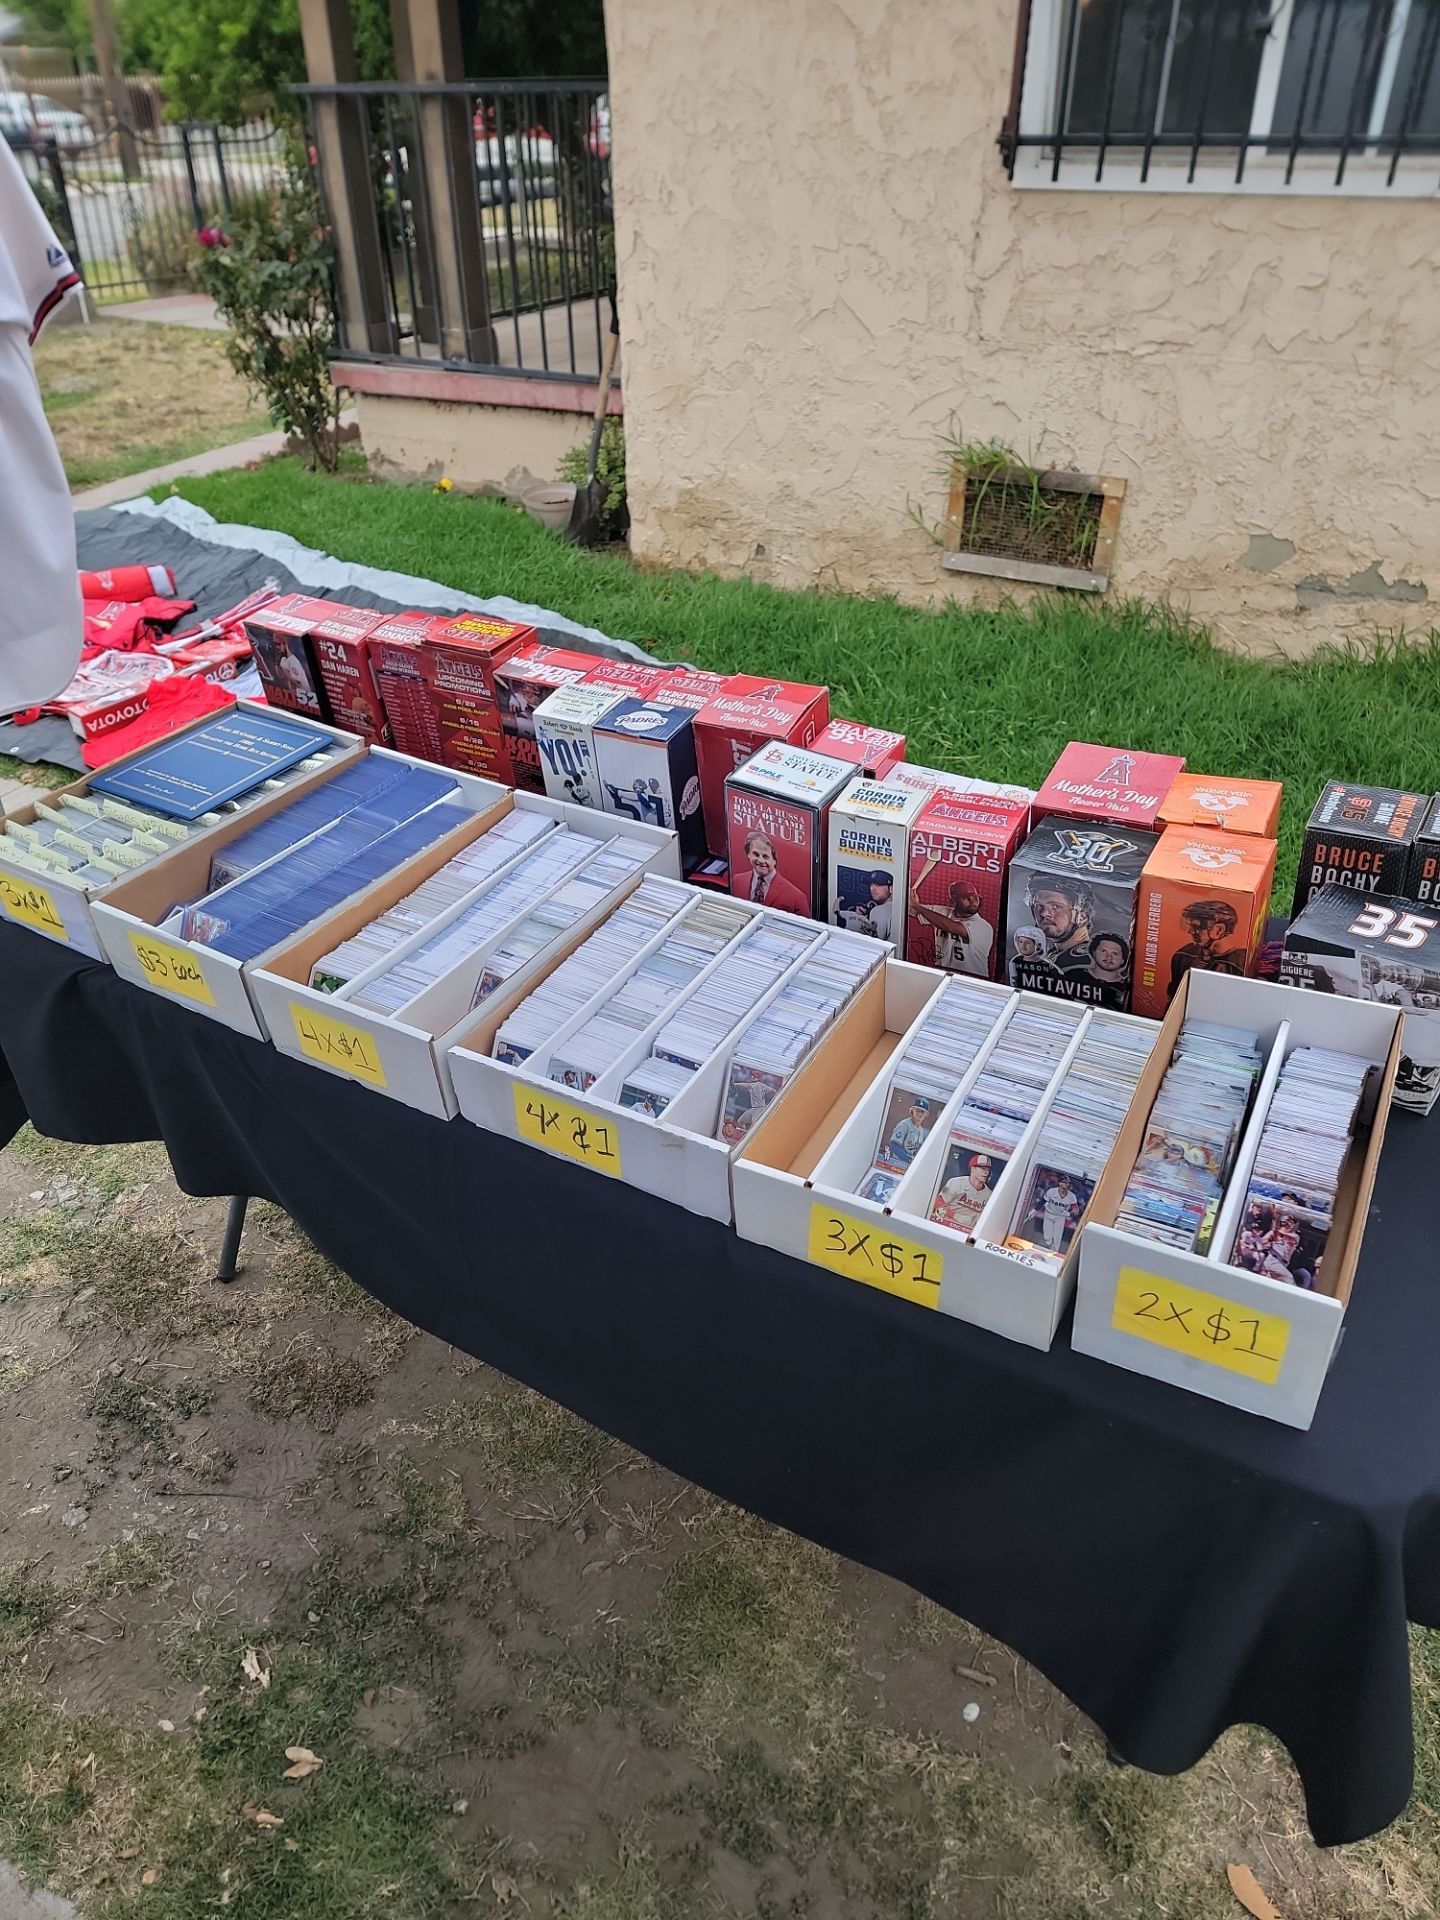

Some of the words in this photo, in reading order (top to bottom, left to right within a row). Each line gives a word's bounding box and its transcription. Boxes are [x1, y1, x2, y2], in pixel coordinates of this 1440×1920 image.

[318, 641, 347, 662] #24
[321, 660, 337, 671] DAN
[336, 663, 360, 678] HAREN
[435, 652, 484, 679] ANGELS
[594, 665, 662, 689] ANGELS
[433, 680, 491, 696] PROMOTIONS
[437, 674, 485, 688] UPCOMING
[296, 687, 320, 709] 52
[86, 700, 147, 732] TOYOTA
[614, 715, 668, 727] PADRES
[709, 697, 763, 715] Mother's
[762, 706, 794, 726] Day
[538, 738, 588, 777] YO!
[782, 761, 836, 781] STATUE
[850, 793, 905, 809] BURNES
[856, 788, 908, 804] CORBIN
[938, 790, 983, 801] ALBERT
[981, 796, 1029, 808] PUJOLS
[942, 795, 1018, 811] BOBBLEHEAD
[1052, 779, 1119, 801] Mother's
[1119, 790, 1160, 810] Day
[1068, 796, 1104, 809] Flower
[1105, 801, 1130, 813] Vase
[733, 795, 757, 809] TONY
[760, 804, 772, 814] LA
[775, 808, 805, 825] RUSSA
[733, 804, 759, 817] HALL
[762, 811, 774, 821] OF
[778, 816, 805, 831] FAME
[928, 802, 1008, 827] ANGELS
[1341, 805, 1369, 821] 15
[1373, 802, 1397, 825] GNOME
[733, 811, 807, 846] STATUE
[840, 829, 892, 849] CORBIN
[918, 820, 958, 832] STADIUM
[957, 826, 1008, 839] EXCLUSIVE
[839, 837, 893, 858] BURNES
[911, 832, 1005, 859] ALBERT
[911, 846, 1001, 873] PUJOLS
[1314, 843, 1385, 874] BRUCE
[1310, 865, 1381, 893] BOCHY
[1147, 892, 1163, 942] SILFVERBERG
[1347, 902, 1438, 949] 35
[953, 947, 966, 962] 5
[1145, 940, 1158, 967] JAKOB
[1281, 965, 1314, 978] GIGUERE
[1022, 972, 1103, 1001] MCTAVISH
[984, 1241, 1036, 1267] ROOKIES
